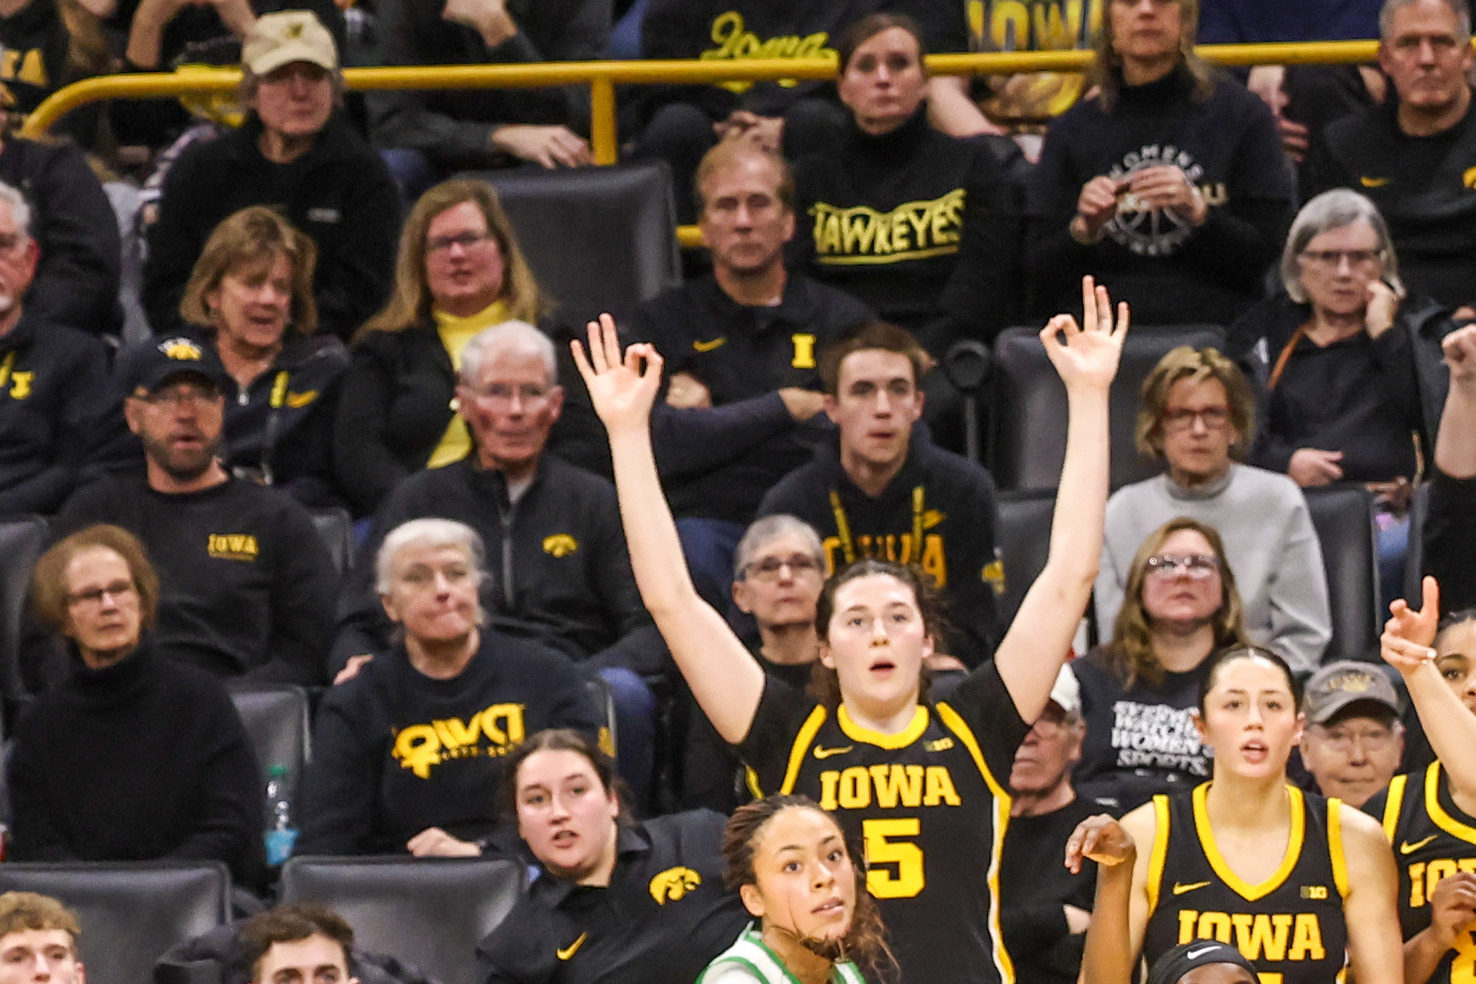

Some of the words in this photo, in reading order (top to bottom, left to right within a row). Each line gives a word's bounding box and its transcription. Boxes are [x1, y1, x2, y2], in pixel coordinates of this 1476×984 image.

[207, 533, 260, 553] IOWA
[820, 764, 962, 811] IOWA
[862, 818, 926, 899] 5
[1178, 909, 1326, 961] IOWA
